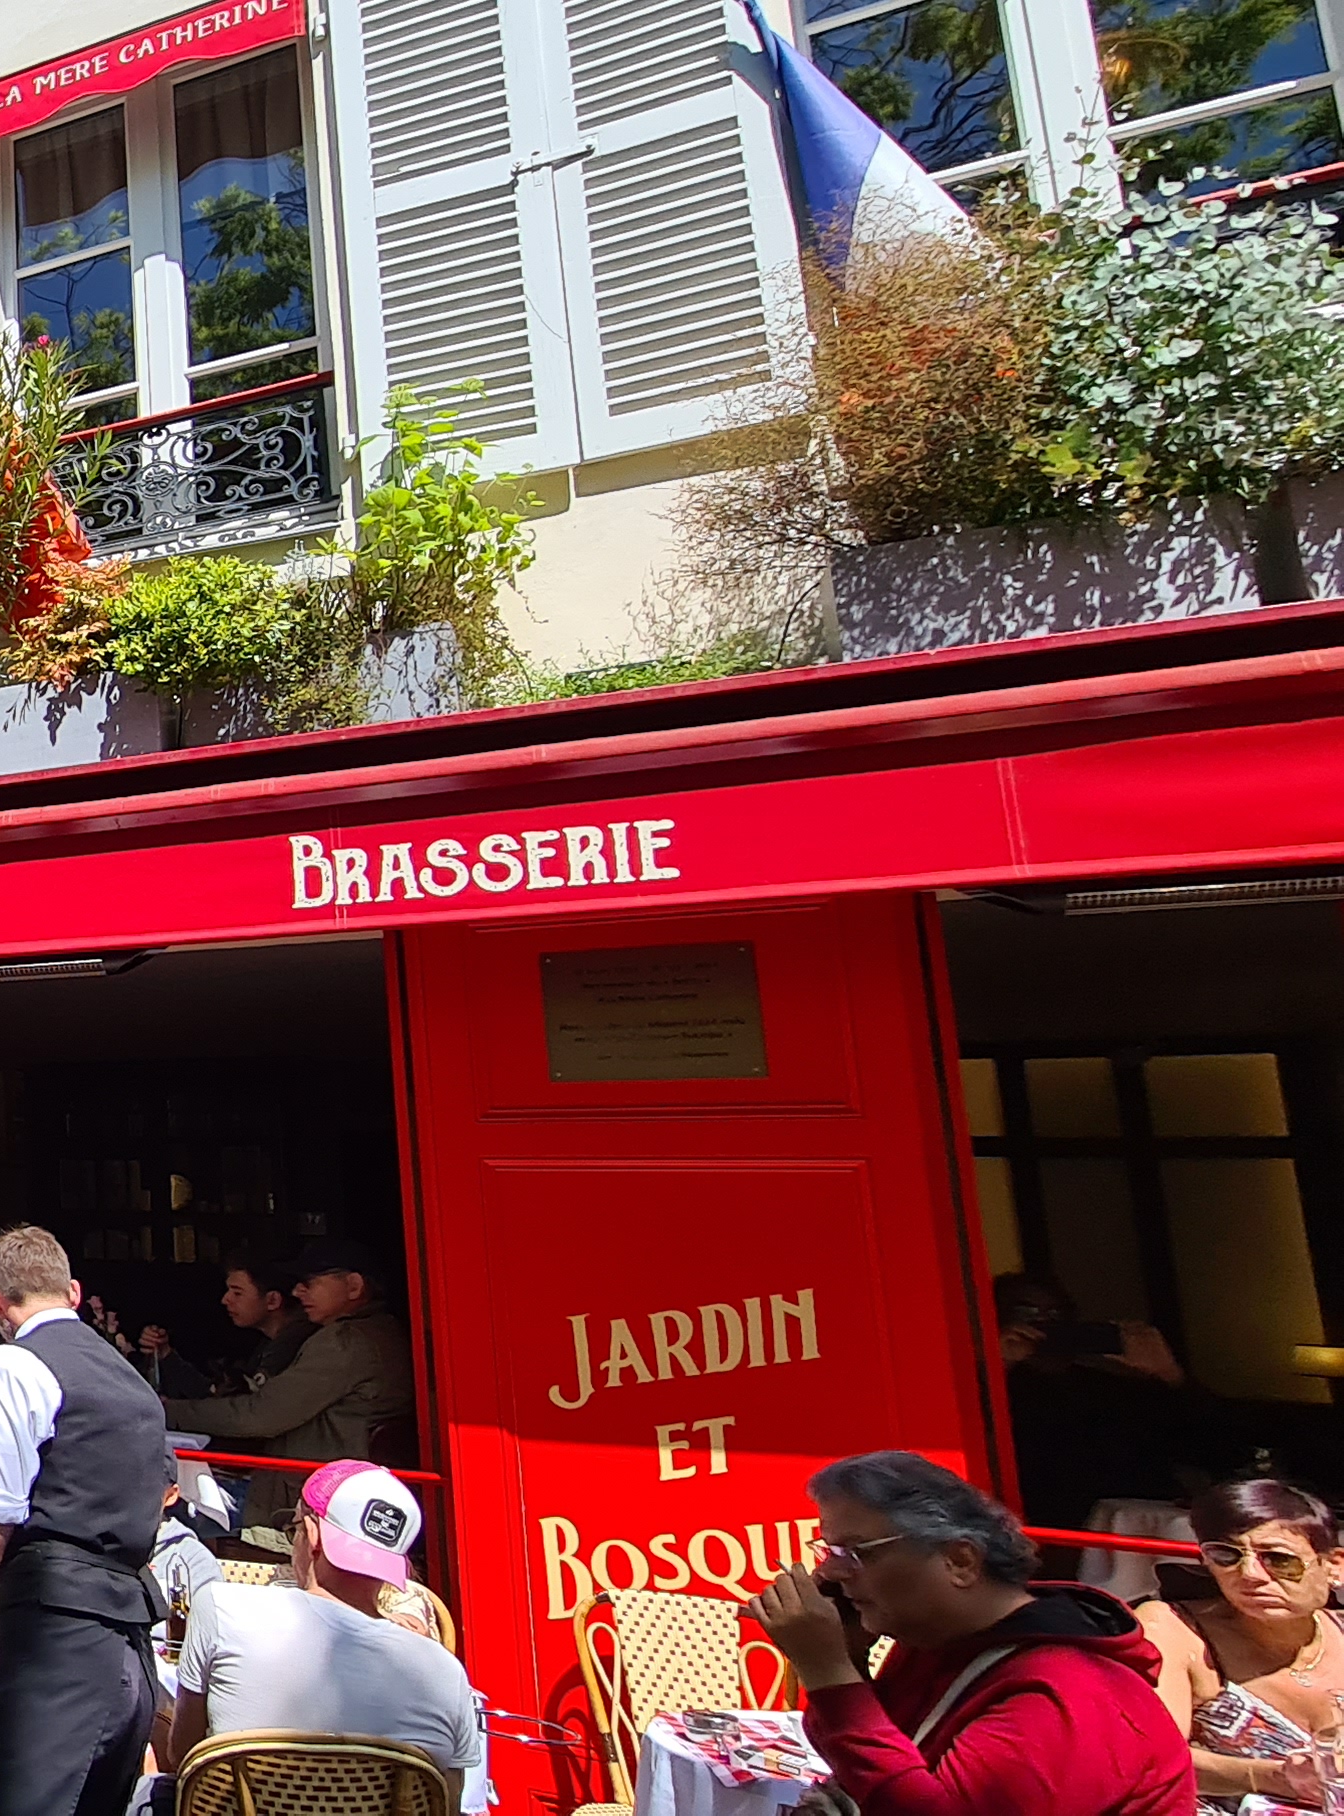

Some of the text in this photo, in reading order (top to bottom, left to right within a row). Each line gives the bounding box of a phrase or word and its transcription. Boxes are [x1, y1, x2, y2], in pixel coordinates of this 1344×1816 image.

[33, 53, 109, 95] MERE
[118, 0, 289, 64] CATHERINE
[288, 819, 681, 910] BRASSERIE
[548, 1287, 821, 1410] JARDIN
[654, 1416, 736, 1481] ET
